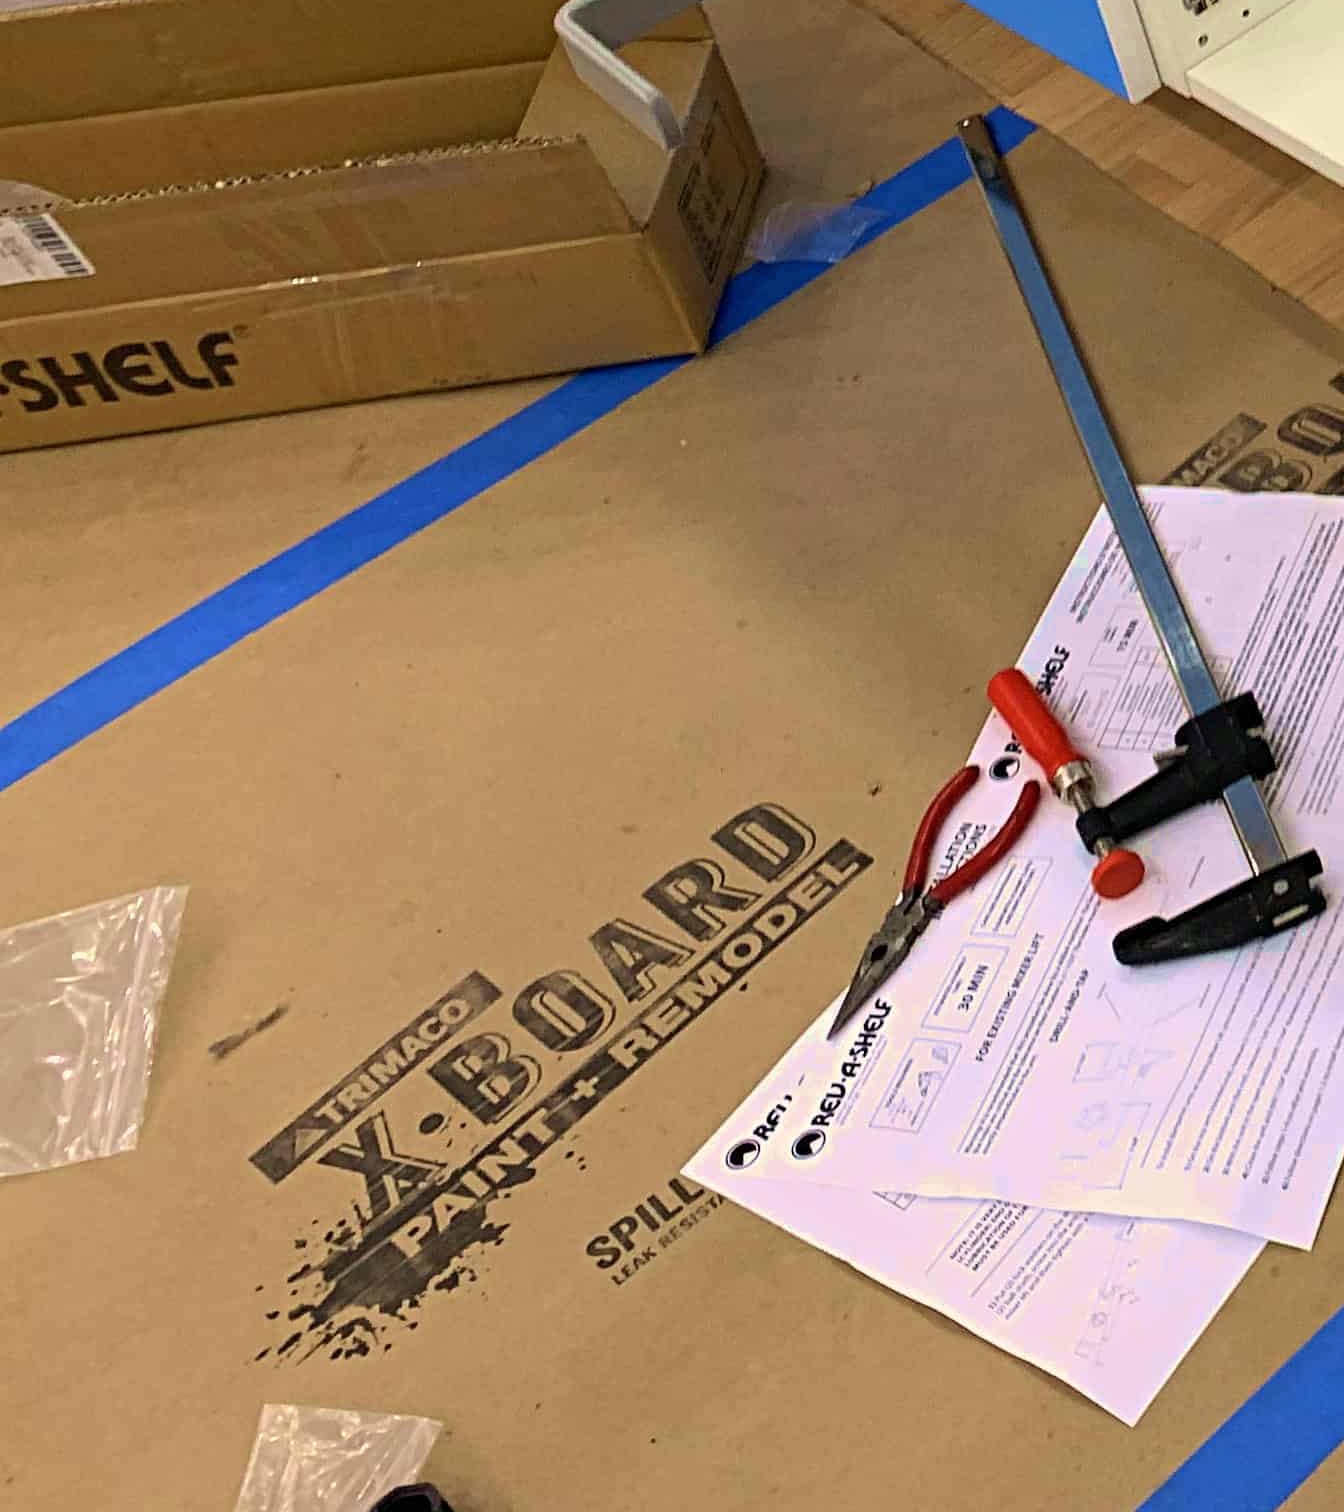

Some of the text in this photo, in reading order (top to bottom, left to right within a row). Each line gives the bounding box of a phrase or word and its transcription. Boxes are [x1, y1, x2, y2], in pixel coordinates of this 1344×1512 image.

[958, 966, 988, 1010] 30 MIN
[976, 933, 1044, 1062] FOR EXISTING MIXER LIFT
[315, 996, 474, 1125] TRIMACO
[397, 1115, 559, 1260] PAINT
[609, 854, 863, 1070] REMODEL
[584, 1168, 706, 1271] SPILL
[609, 1245, 659, 1288] LEAK
